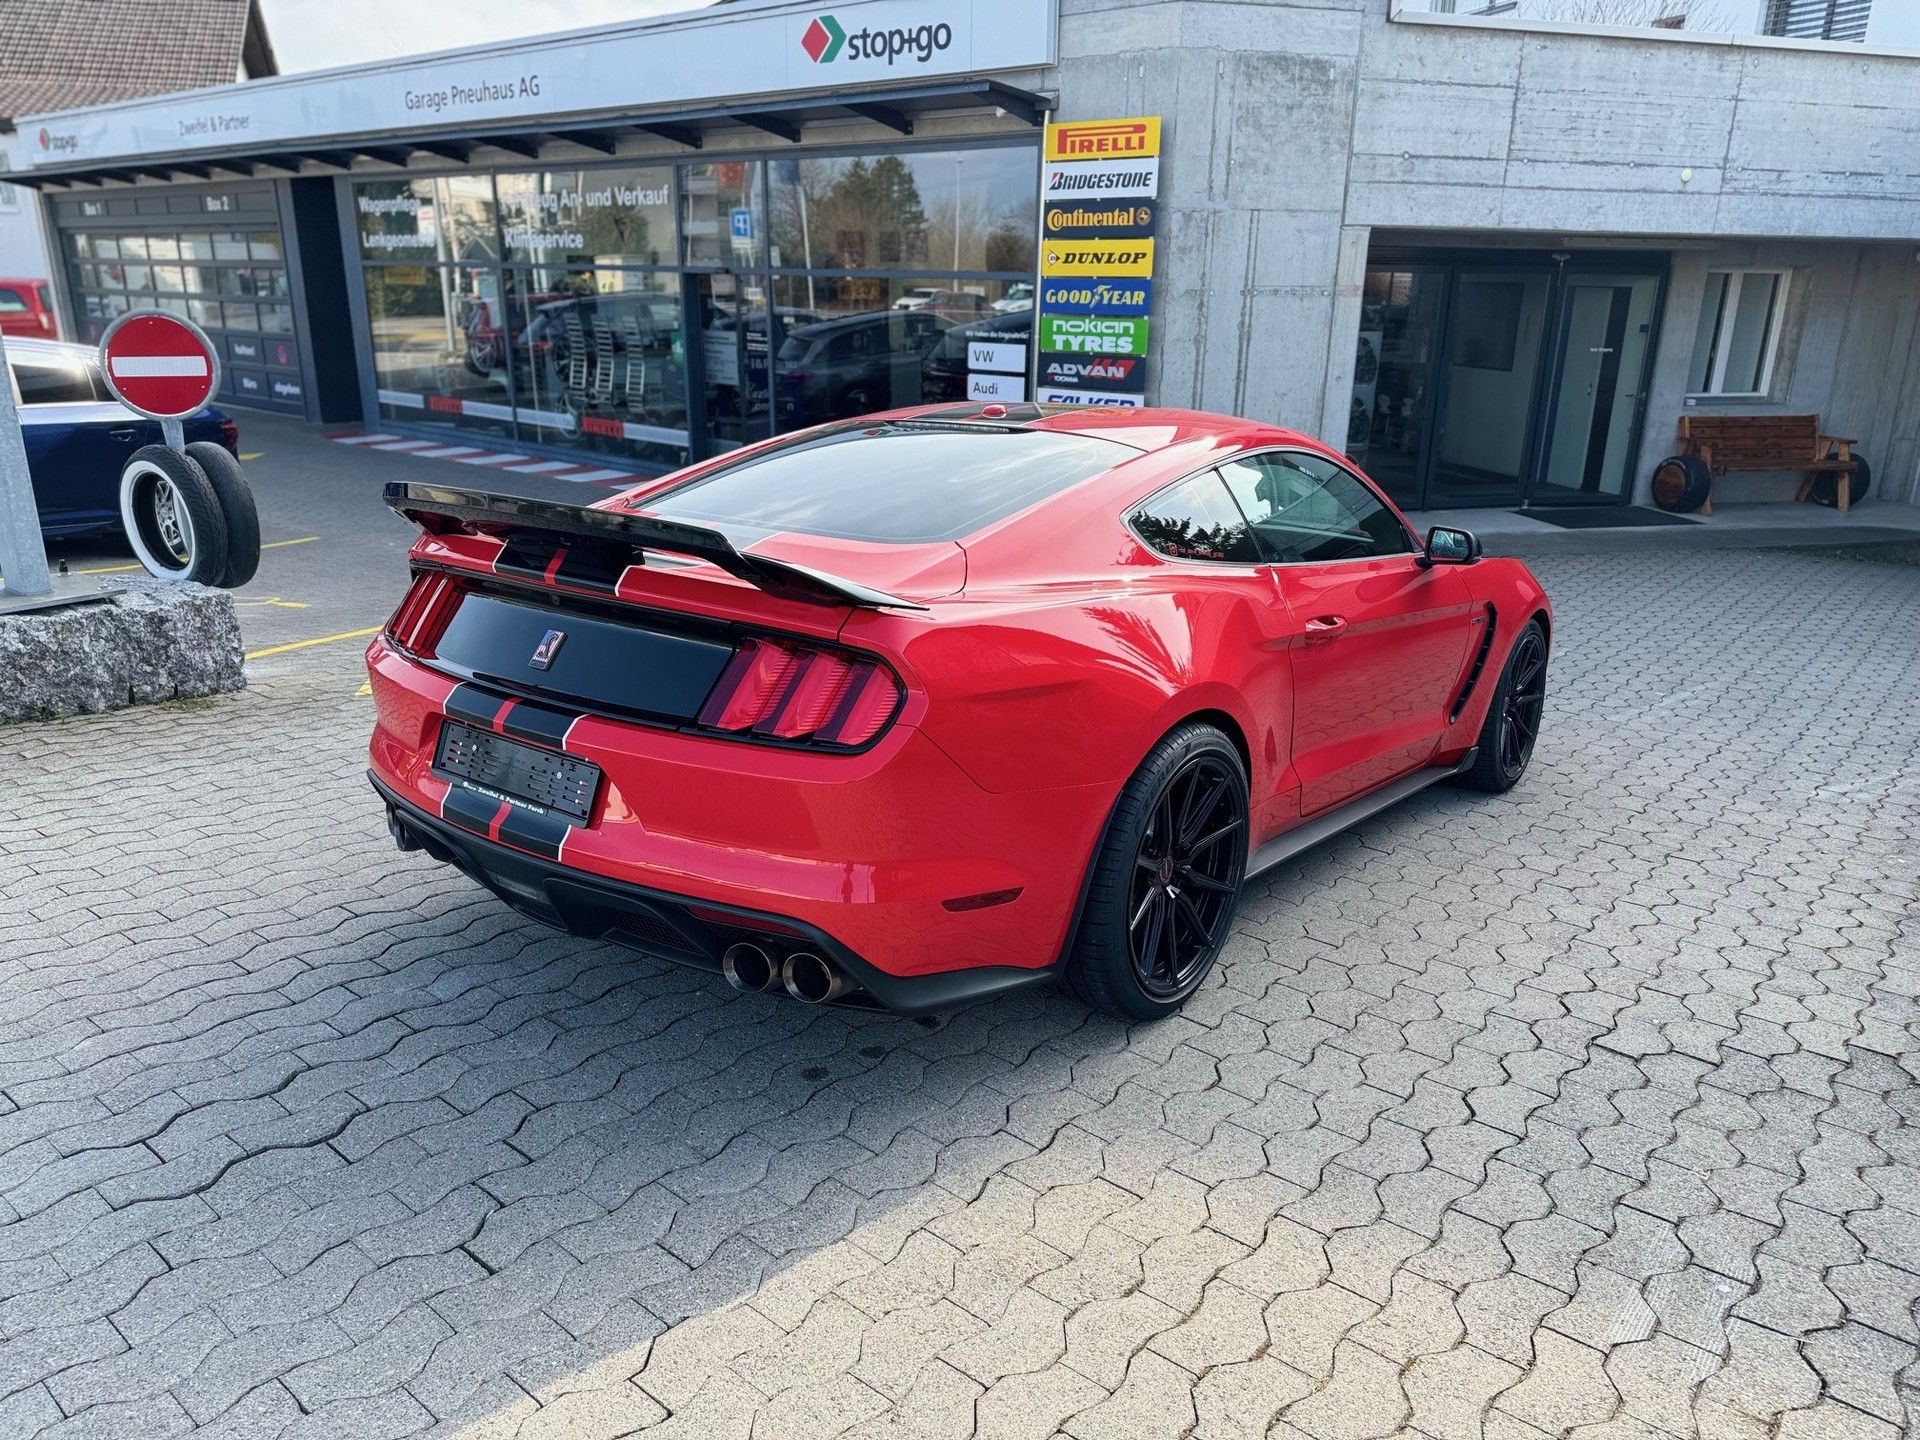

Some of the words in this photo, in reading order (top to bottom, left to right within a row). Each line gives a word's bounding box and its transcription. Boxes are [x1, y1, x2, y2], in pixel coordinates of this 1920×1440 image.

[848, 22, 952, 66] stop+go
[404, 90, 448, 113] Garage
[451, 80, 515, 105] Pneuhaus
[519, 75, 541, 98] AG
[218, 114, 250, 132] Partner
[1057, 123, 1147, 154] PIRELLI
[1048, 171, 1153, 191] BRIDGESTONE
[206, 197, 221, 212] Box
[222, 196, 230, 211] 2
[585, 187, 612, 207] und
[613, 184, 669, 206] Verkauf
[1046, 207, 1135, 231] Continental
[503, 228, 584, 249] Klimaservice
[1062, 252, 1147, 265] DUNLOP
[1052, 334, 1134, 353] TYRES
[973, 350, 994, 363] VW
[1047, 363, 1125, 378] ADVAN
[973, 381, 998, 395] Audi
[505, 796, 527, 809] Partner
